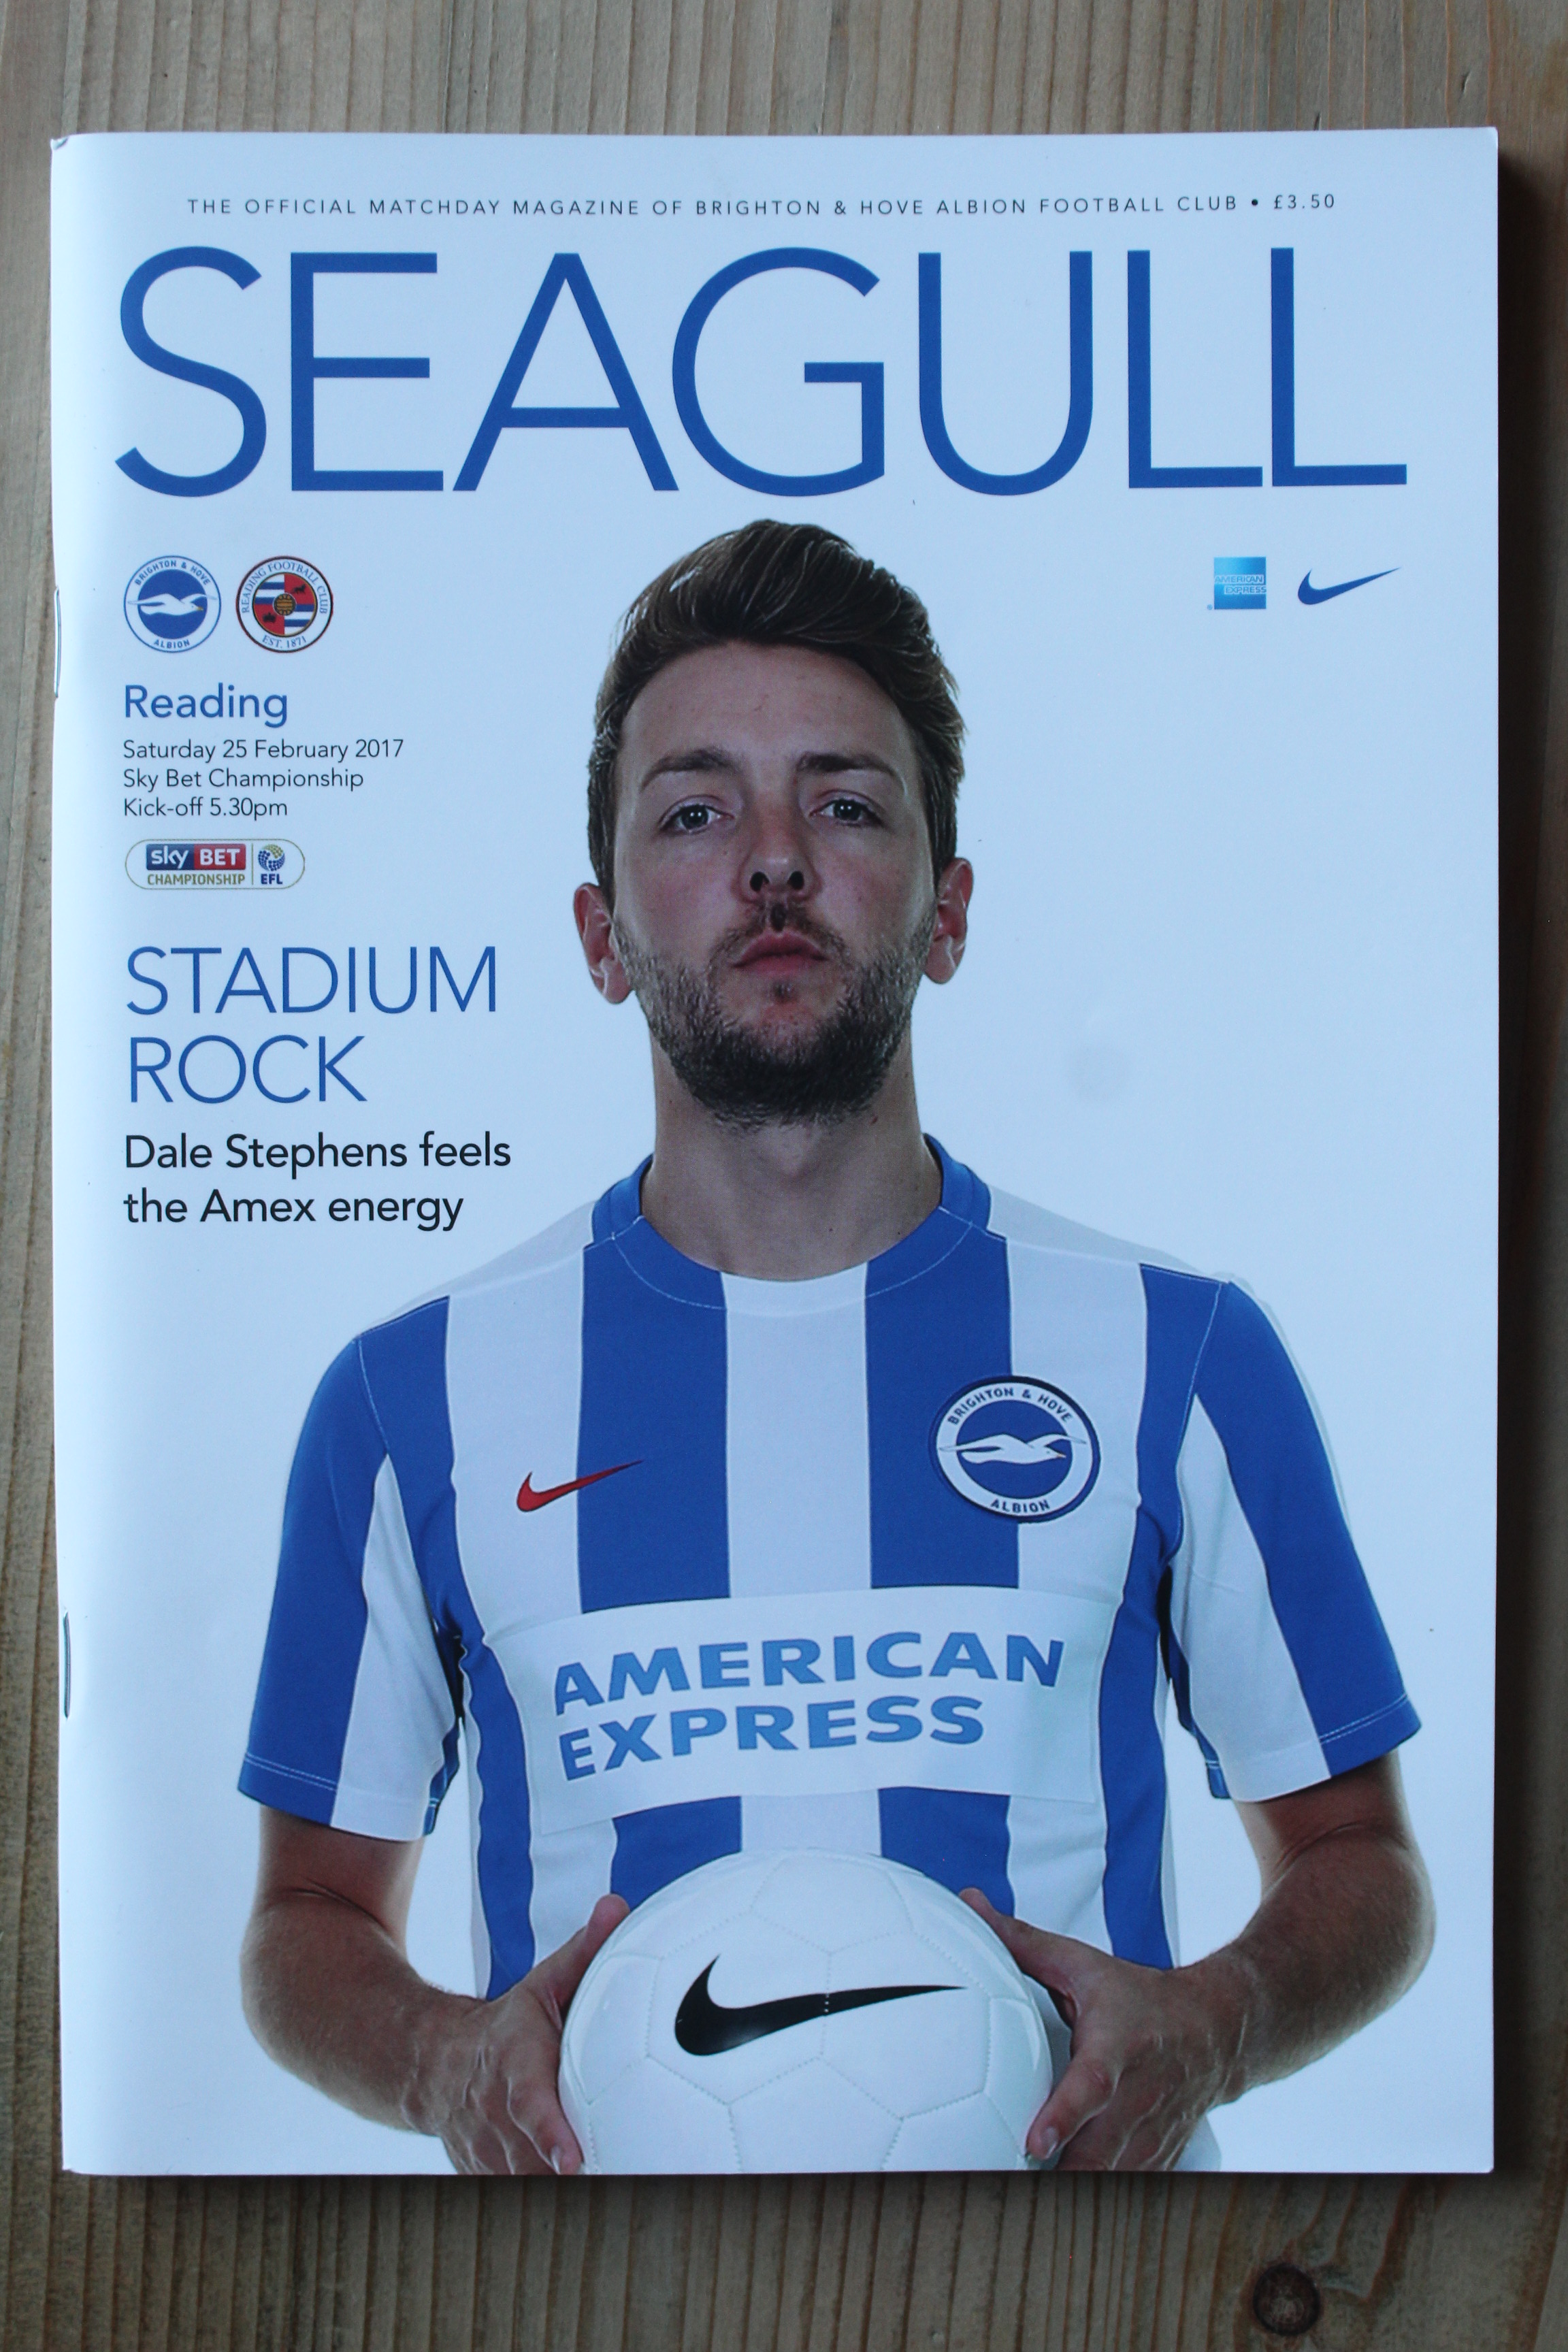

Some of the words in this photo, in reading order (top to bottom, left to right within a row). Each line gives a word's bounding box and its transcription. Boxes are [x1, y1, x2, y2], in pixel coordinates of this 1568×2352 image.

[188, 199, 232, 214] THE
[245, 199, 357, 215] OFFICIAL
[369, 199, 501, 215] MATCHDAY
[513, 199, 640, 215] MAGAZINE
[653, 199, 683, 215] OF
[696, 199, 821, 215] BRIGHTON
[834, 200, 847, 215] &
[860, 199, 924, 215] HOVE
[936, 199, 1027, 214] ALBION
[1040, 197, 1164, 214] FOOTBALL
[1177, 195, 1238, 212] CLUB
[1273, 193, 1336, 210] £3.50
[114, 245, 1408, 497] SEAGULL
[134, 560, 177, 586] BRIGHTON
[190, 565, 212, 585] HOVE
[241, 568, 267, 614] READING
[267, 560, 318, 587] FOOTBALL
[316, 585, 329, 614] CLUB
[1225, 585, 1267, 594] EXPRESS
[154, 638, 191, 649] ALBION
[262, 634, 283, 649] EST.
[286, 636, 307, 648] 1871
[125, 683, 288, 728] Reading
[123, 739, 216, 763] Saturday
[223, 740, 248, 758] 25
[255, 739, 348, 762] February
[355, 739, 404, 757] 2017
[123, 768, 159, 791] Sky
[167, 769, 202, 787] Bet
[208, 768, 364, 791] Championship
[124, 797, 203, 817] Kick-off
[210, 798, 288, 821] 5.30pm
[151, 847, 189, 868] sky
[199, 848, 240, 865] BET
[147, 874, 246, 885] CHAMPIONSHIP
[261, 873, 283, 885] EFL
[127, 945, 496, 1015] STADIUM
[130, 1034, 368, 1104] ROCK
[126, 1132, 212, 1169] Dale
[225, 1131, 408, 1180] Stephens
[419, 1130, 512, 1167] feels
[123, 1187, 188, 1223] the
[199, 1188, 316, 1222] Amex
[328, 1197, 464, 1232] energy
[947, 1387, 1014, 1425] BRIGHTON
[1022, 1389, 1032, 1399] &
[1038, 1393, 1073, 1423] HOVE
[991, 1499, 1051, 1514] ALBION
[554, 1631, 1064, 1716] AMERICAN
[558, 1695, 985, 1782] EXPRESS
